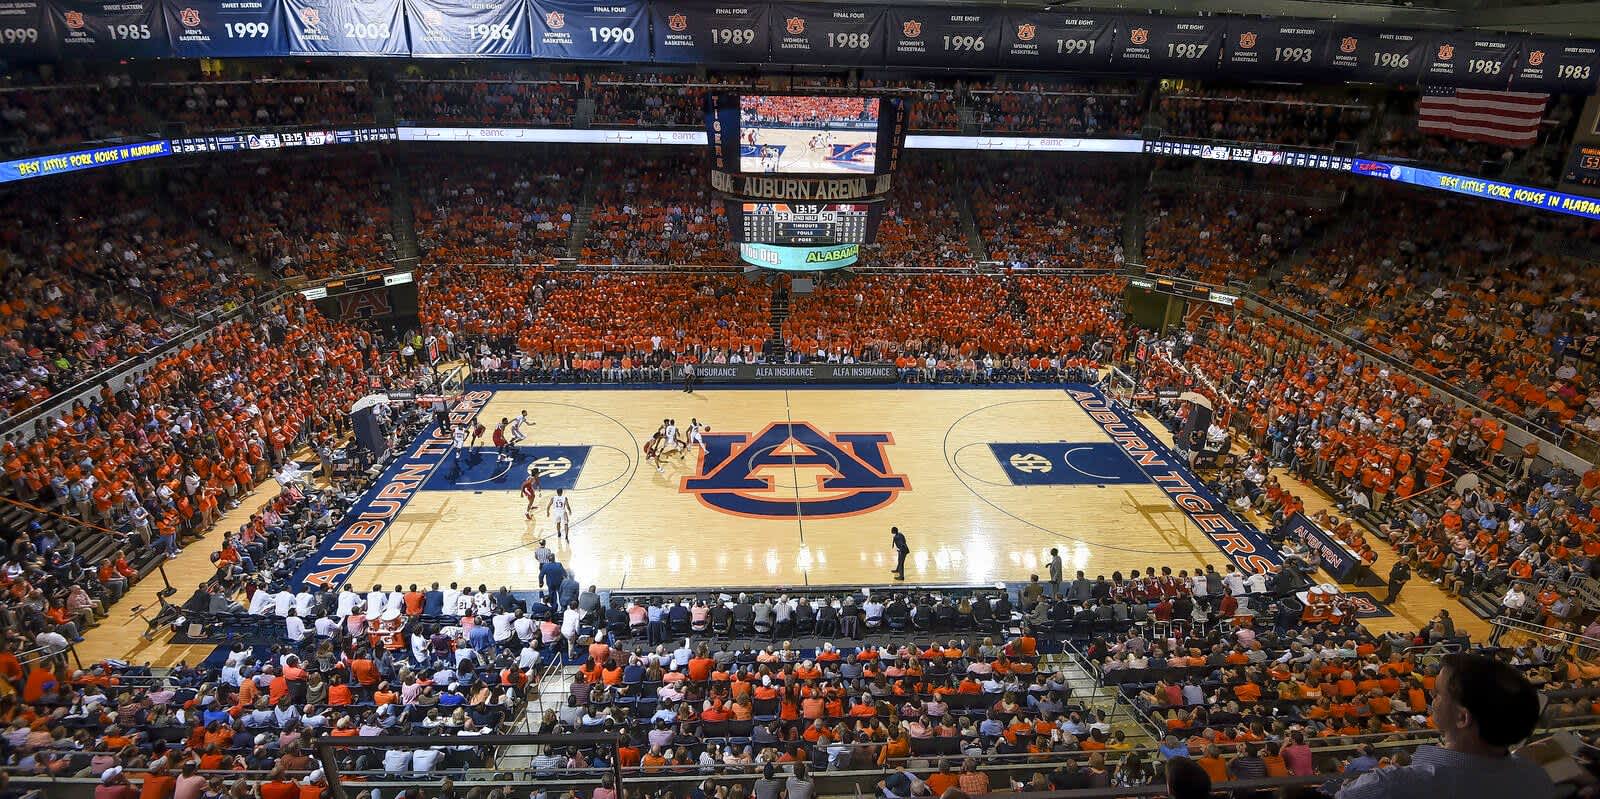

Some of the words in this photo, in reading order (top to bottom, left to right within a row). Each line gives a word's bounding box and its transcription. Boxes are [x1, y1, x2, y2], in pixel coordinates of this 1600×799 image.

[108, 25, 151, 40] 1985
[225, 22, 268, 38] 1999
[344, 23, 390, 39] 2003
[469, 23, 514, 40] 1986
[590, 27, 634, 43] 1990
[712, 29, 754, 44] 1989
[828, 33, 870, 48] 1988
[943, 36, 985, 51] 1996
[1057, 40, 1095, 54] 1991
[1168, 43, 1208, 58] 1987
[1275, 47, 1312, 62] 1993
[1373, 53, 1409, 68] 1986
[1468, 60, 1501, 75] 1985
[1558, 65, 1590, 80] 1983
[264, 139, 277, 147] 53
[281, 133, 303, 142] 13:15
[1215, 151, 1226, 159] 53
[1232, 148, 1252, 157] 13:15
[43, 157, 67, 172] LITTLE
[70, 153, 93, 167] PORK
[94, 150, 118, 162] HOUSE
[121, 149, 129, 158] IN
[743, 177, 811, 199] AUBURN
[815, 177, 868, 199] ARENA
[1461, 179, 1486, 193] LITTLE
[1488, 183, 1512, 199] PORK
[1514, 188, 1546, 205] HOUSE
[1548, 195, 1561, 207] IN
[777, 212, 790, 221] 53
[821, 212, 834, 221] 50
[795, 204, 817, 214] 13:15
[761, 248, 781, 265] Dig.
[1131, 280, 1152, 288] verizon
[697, 367, 737, 377] INSURANCE
[755, 367, 773, 377] ALFA
[774, 367, 814, 377] INSURANCE
[832, 367, 851, 376] ALFA
[851, 367, 890, 377] INSURANCE
[1067, 388, 1169, 467] AUBURN
[1152, 470, 1280, 576] TIGERS
[302, 463, 434, 590] AUBURN
[1294, 525, 1343, 569] AUBURN
[459, 601, 467, 610] 21
